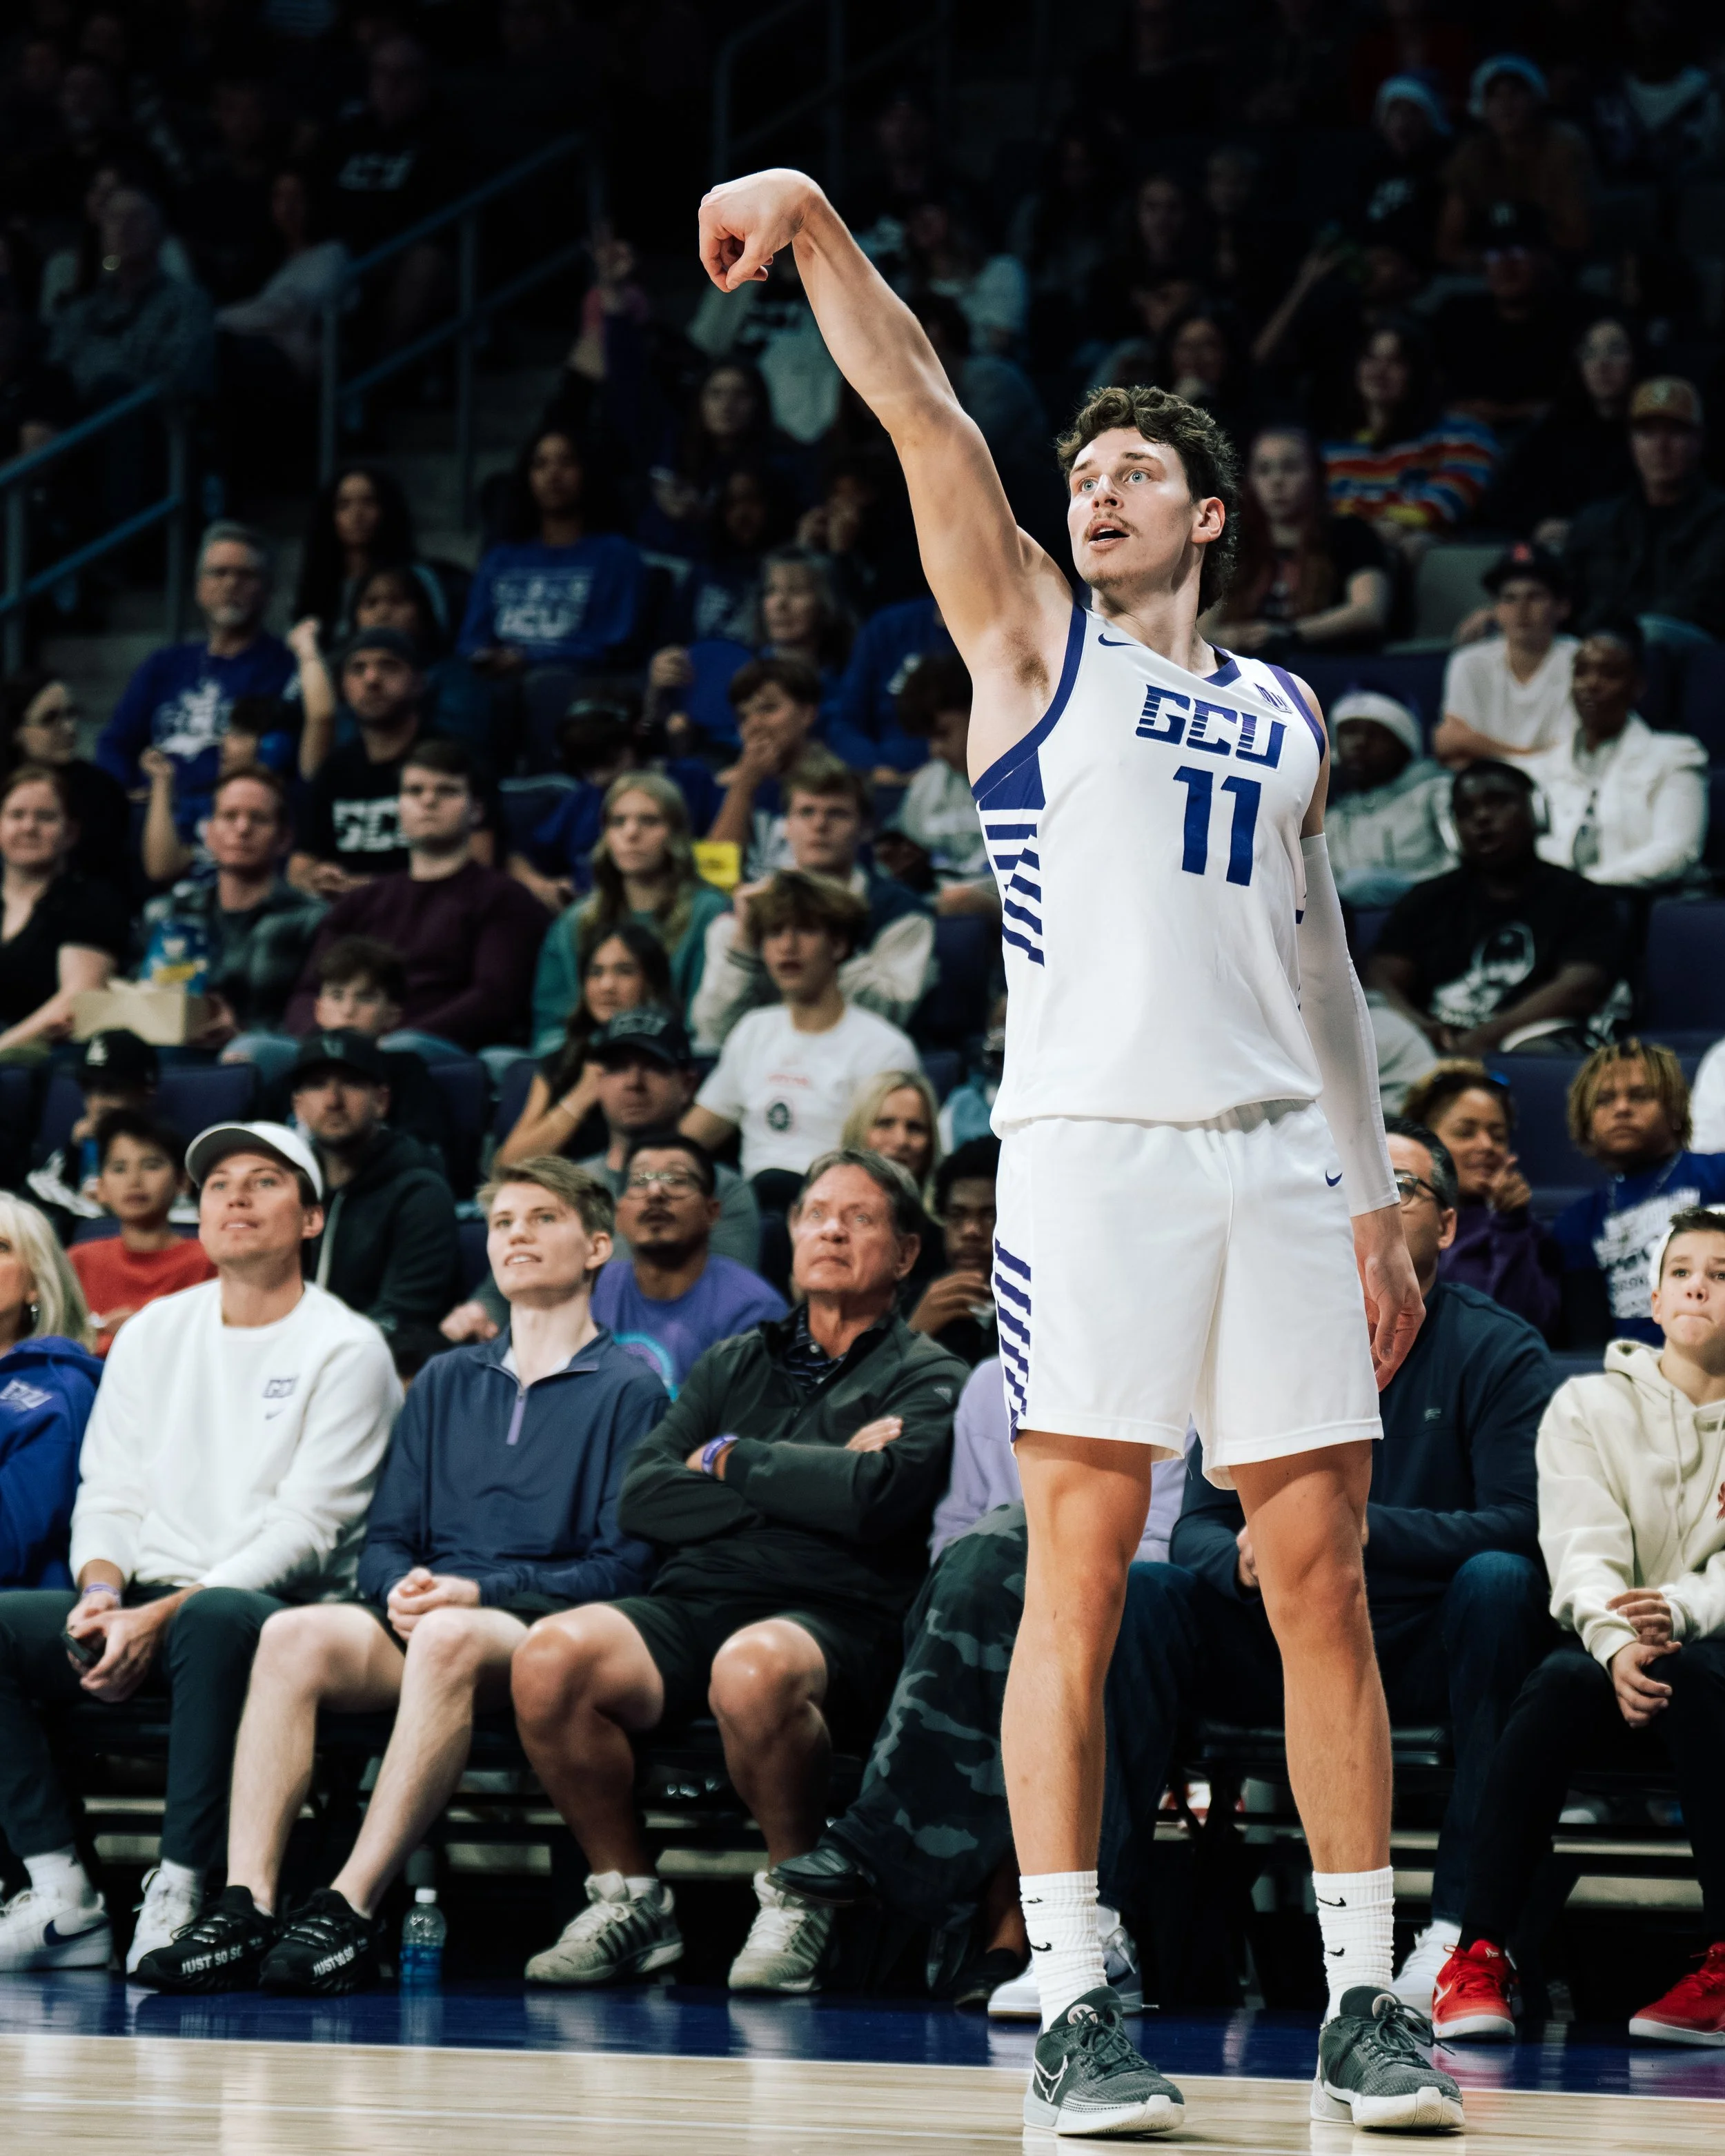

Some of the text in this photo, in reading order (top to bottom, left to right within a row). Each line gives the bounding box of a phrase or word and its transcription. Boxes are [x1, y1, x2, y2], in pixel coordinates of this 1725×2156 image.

[1134, 683, 1289, 770] GCU
[1173, 765, 1262, 887] 11
[215, 1950, 228, 1966] SO
